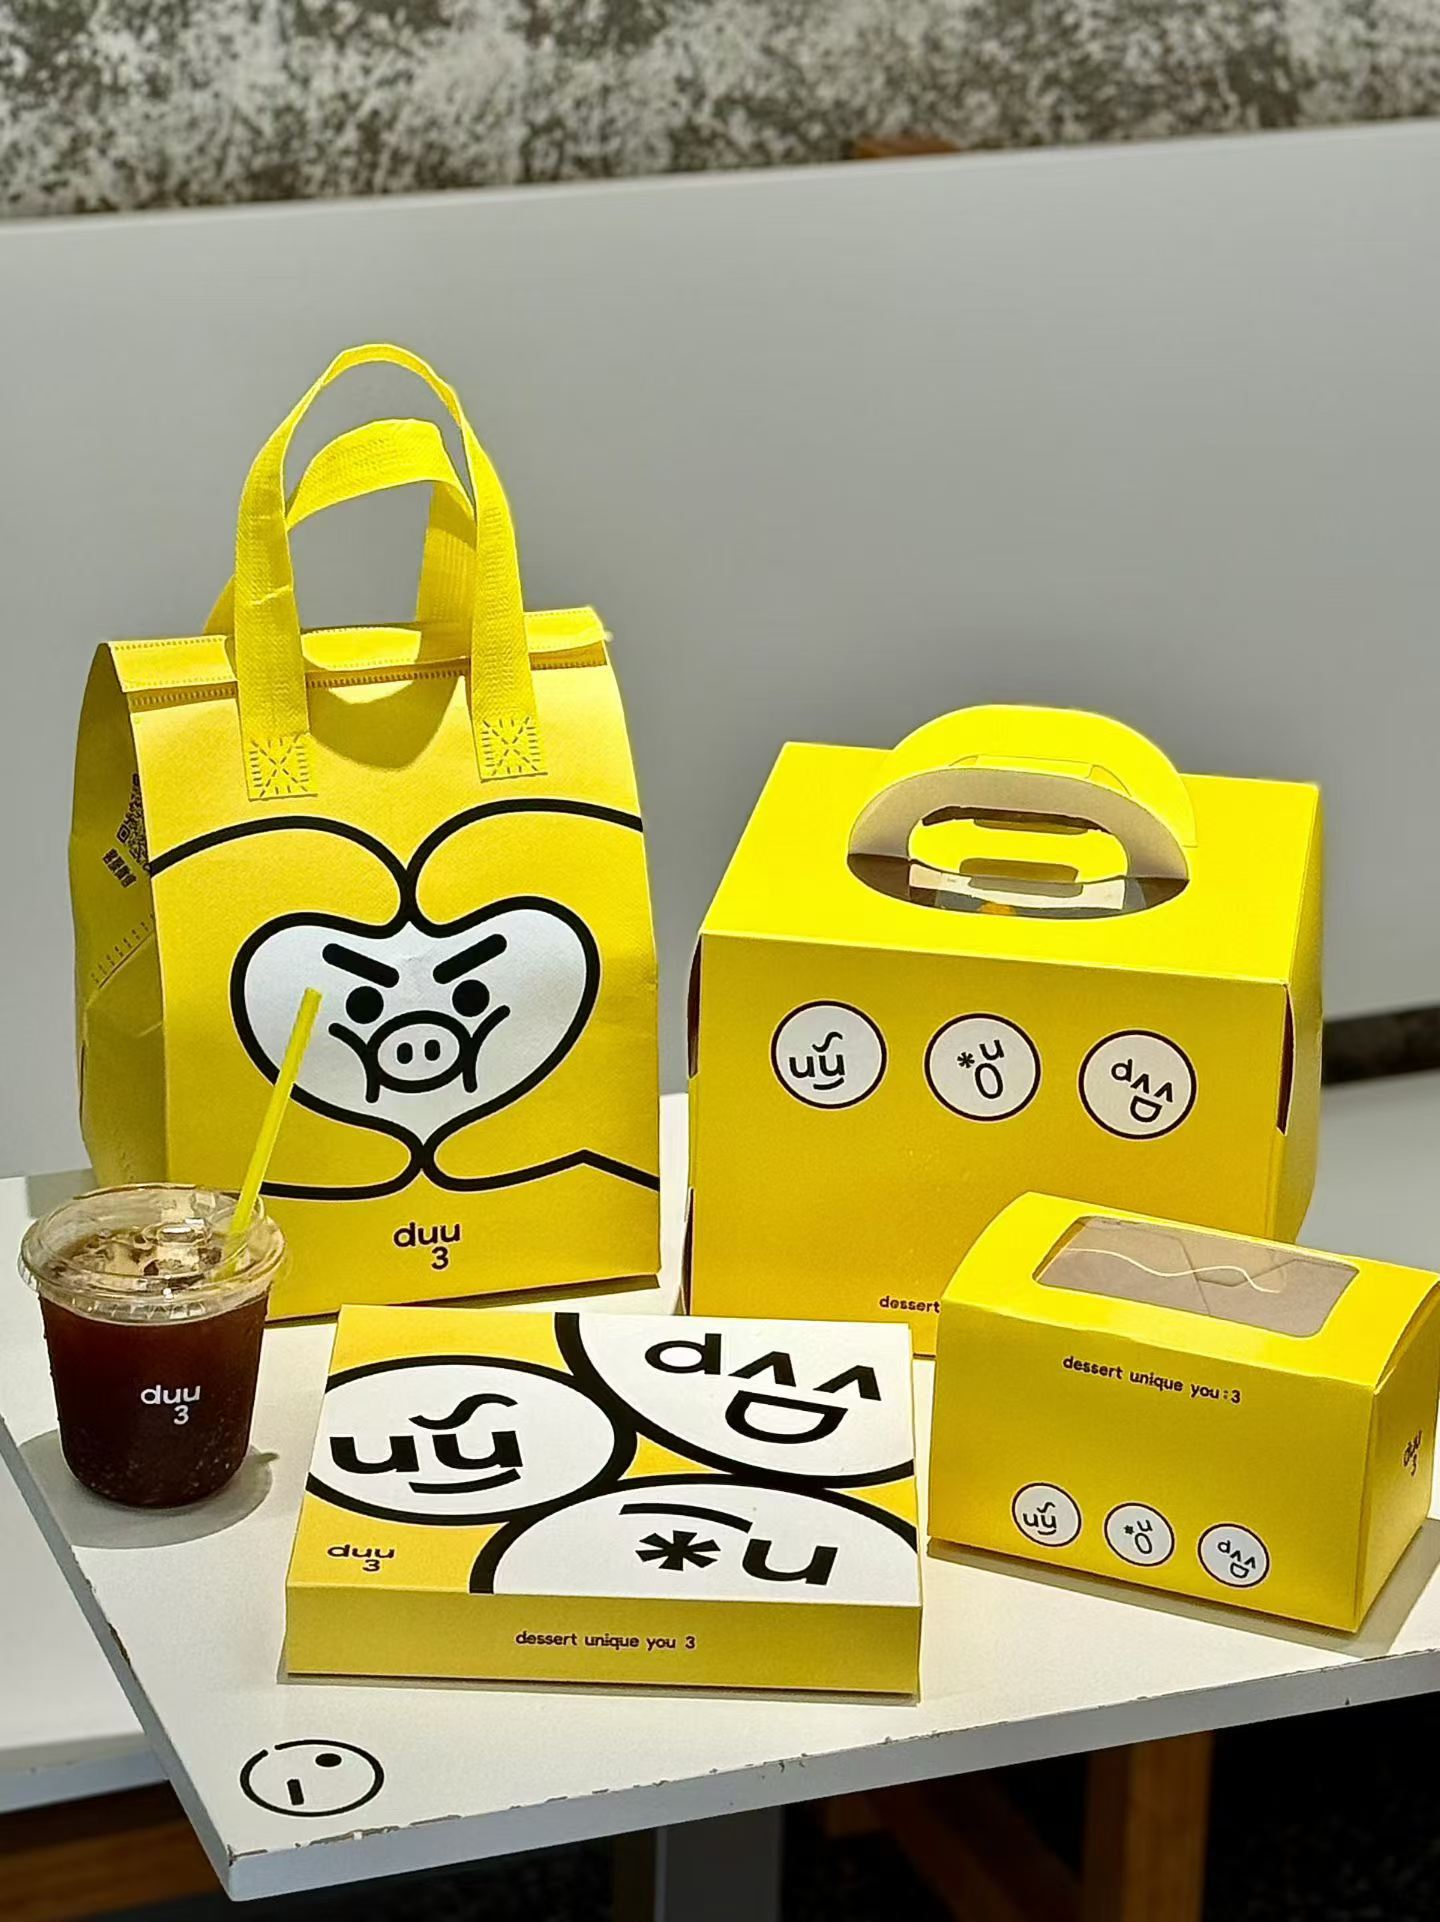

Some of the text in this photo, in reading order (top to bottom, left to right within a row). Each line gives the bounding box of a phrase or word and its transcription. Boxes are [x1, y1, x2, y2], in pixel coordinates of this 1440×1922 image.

[394, 1222, 460, 1248] duu
[431, 1246, 449, 1270] 3
[879, 1295, 940, 1313] dessert
[1062, 1355, 1123, 1380] dessert
[1129, 1371, 1184, 1392] unique
[140, 1384, 201, 1405] duu
[173, 1405, 190, 1425] 3
[327, 1543, 395, 1560] duu
[363, 1559, 381, 1572] 3
[515, 1630, 578, 1646] dessert
[584, 1632, 640, 1651] unique
[646, 1637, 676, 1652] you
